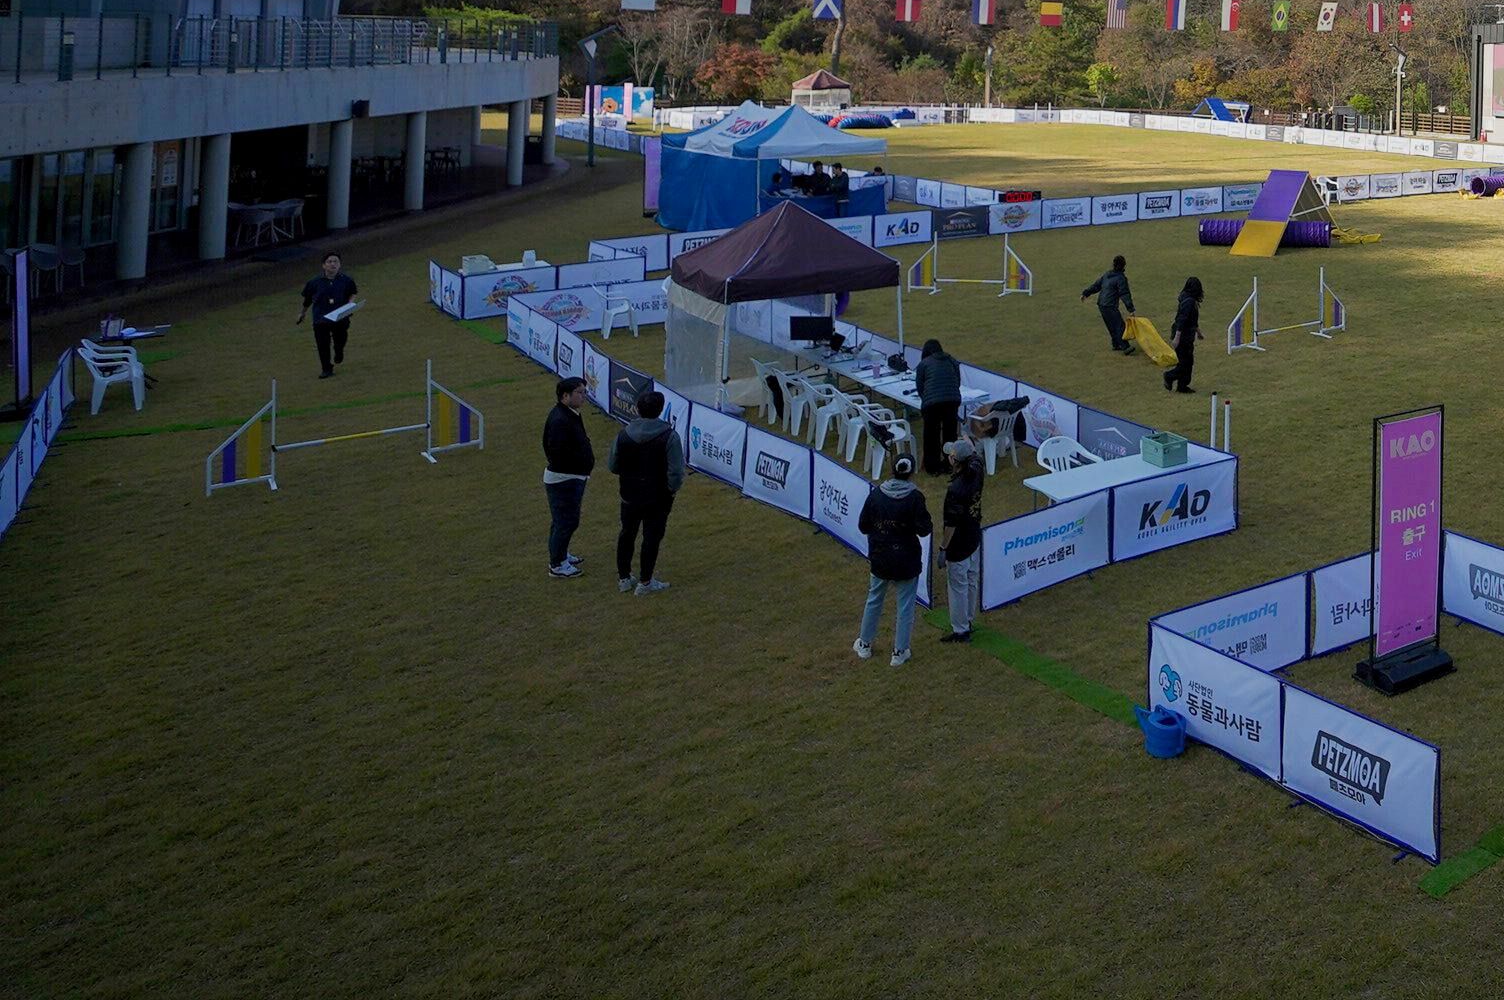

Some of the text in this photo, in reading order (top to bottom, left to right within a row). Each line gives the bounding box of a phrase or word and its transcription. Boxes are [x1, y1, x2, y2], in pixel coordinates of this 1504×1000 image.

[702, 440, 733, 466] 동물과사람
[1389, 430, 1435, 459] KAO
[757, 453, 786, 484] PETZMOA
[820, 479, 849, 517] 강아지숲
[1391, 500, 1435, 524] RING 1
[1004, 523, 1074, 555] phamison
[1027, 543, 1075, 571] 맥스앤몰리
[1405, 547, 1423, 561] Exit
[1188, 680, 1214, 700] 사단법인
[1186, 692, 1262, 742] 동물과사람
[1318, 735, 1380, 794] PETZMOA
